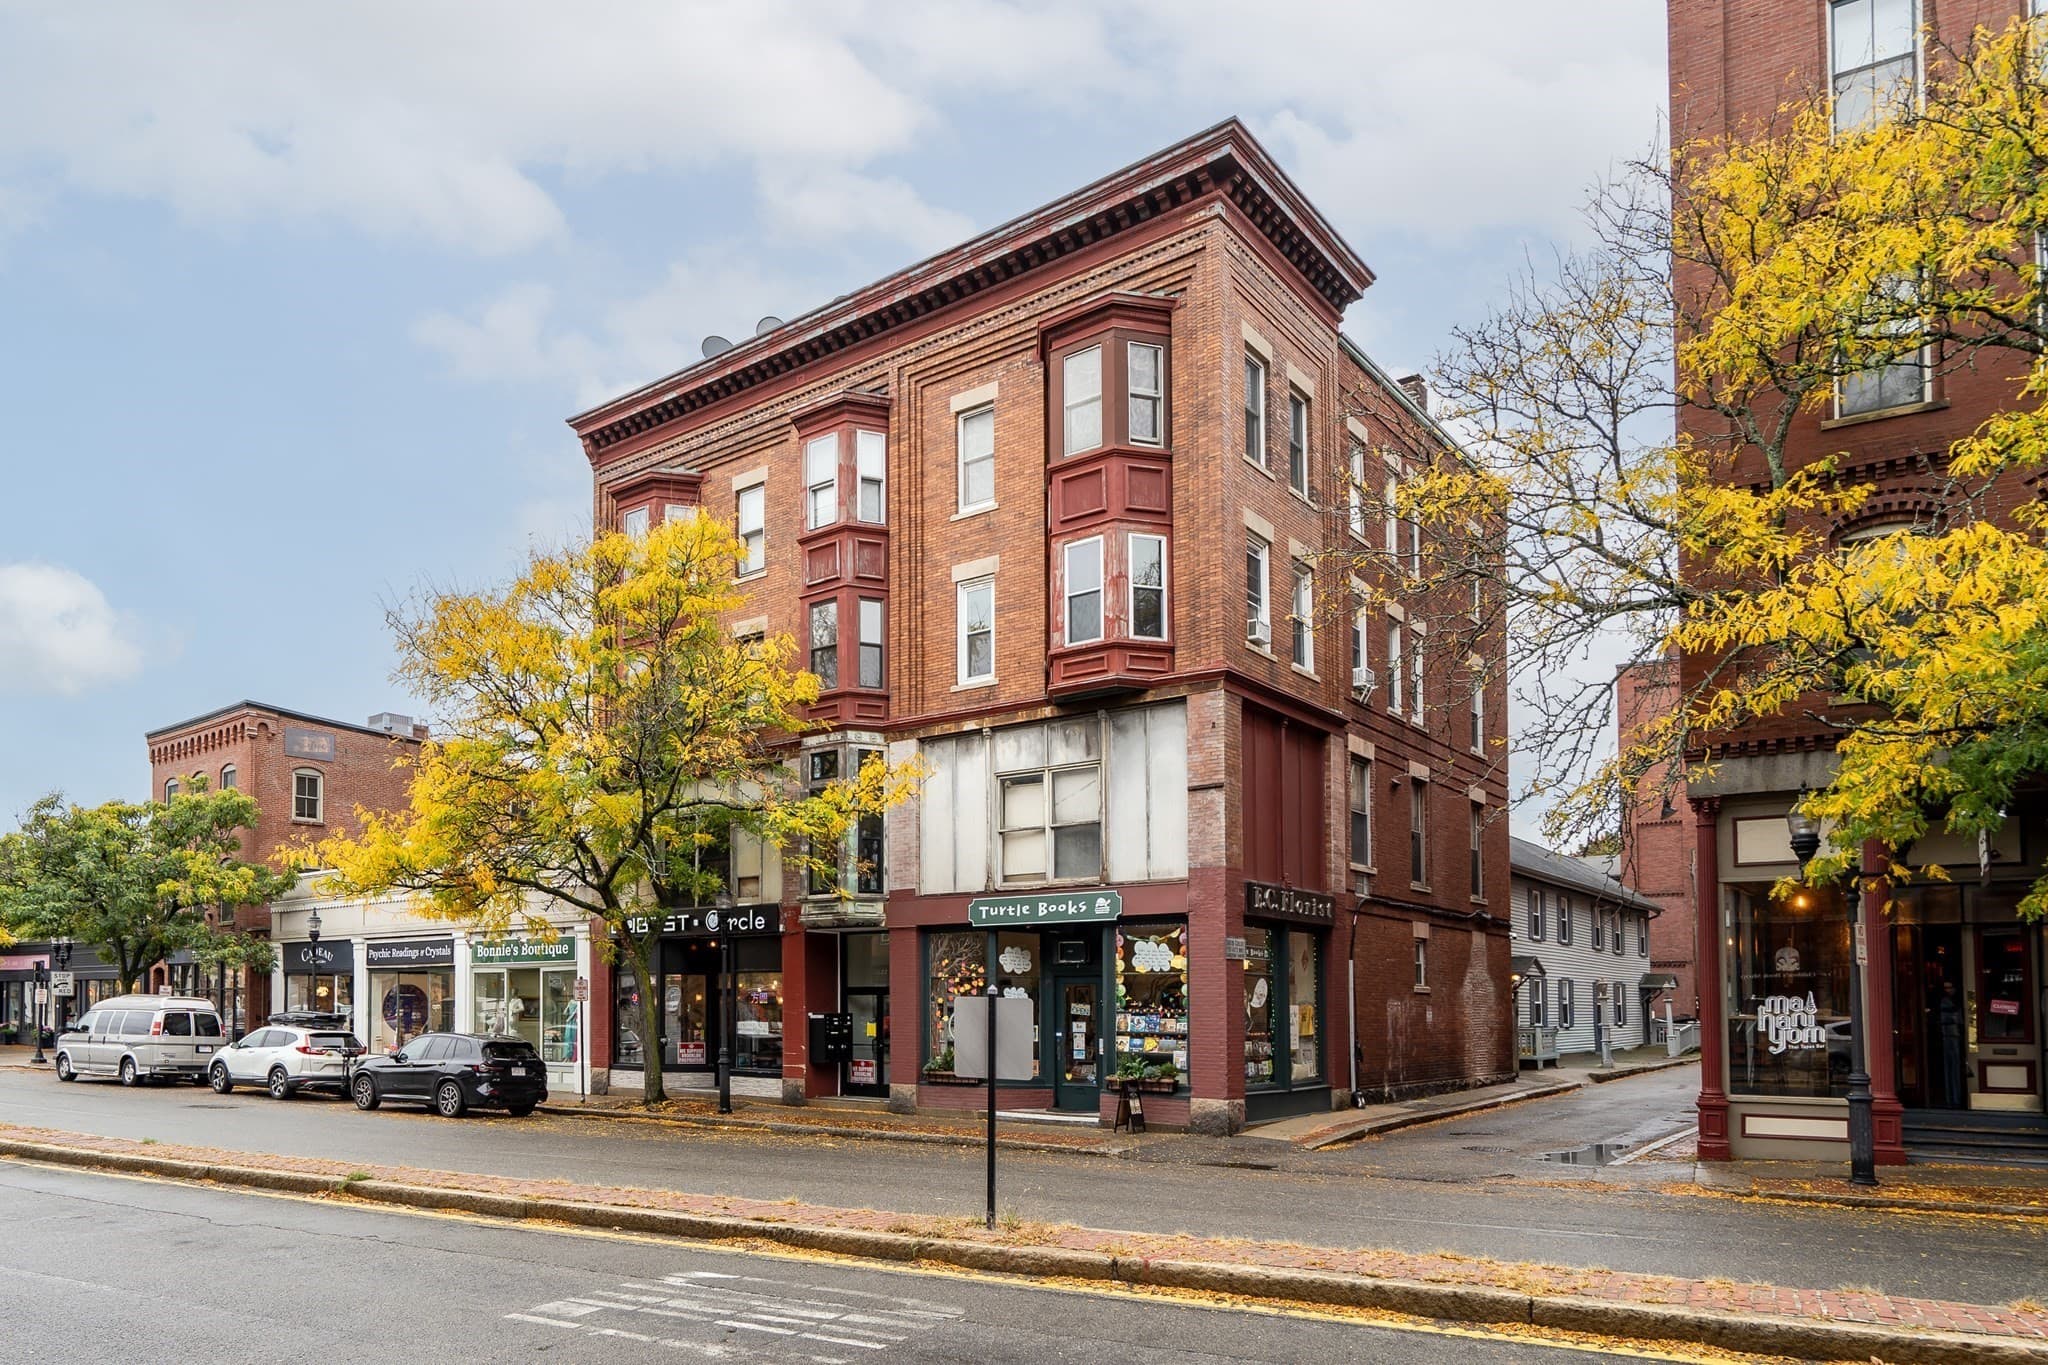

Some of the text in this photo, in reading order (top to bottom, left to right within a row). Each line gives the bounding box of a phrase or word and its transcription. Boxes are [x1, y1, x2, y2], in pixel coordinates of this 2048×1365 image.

[979, 900, 1087, 919] Turtle Books
[1280, 890, 1332, 918] Florist
[705, 909, 766, 932] Crcle
[368, 947, 392, 960] Psychic
[392, 947, 420, 959] Readings
[425, 945, 451, 958] Crystals
[476, 943, 569, 957] Bonnie's Boutique
